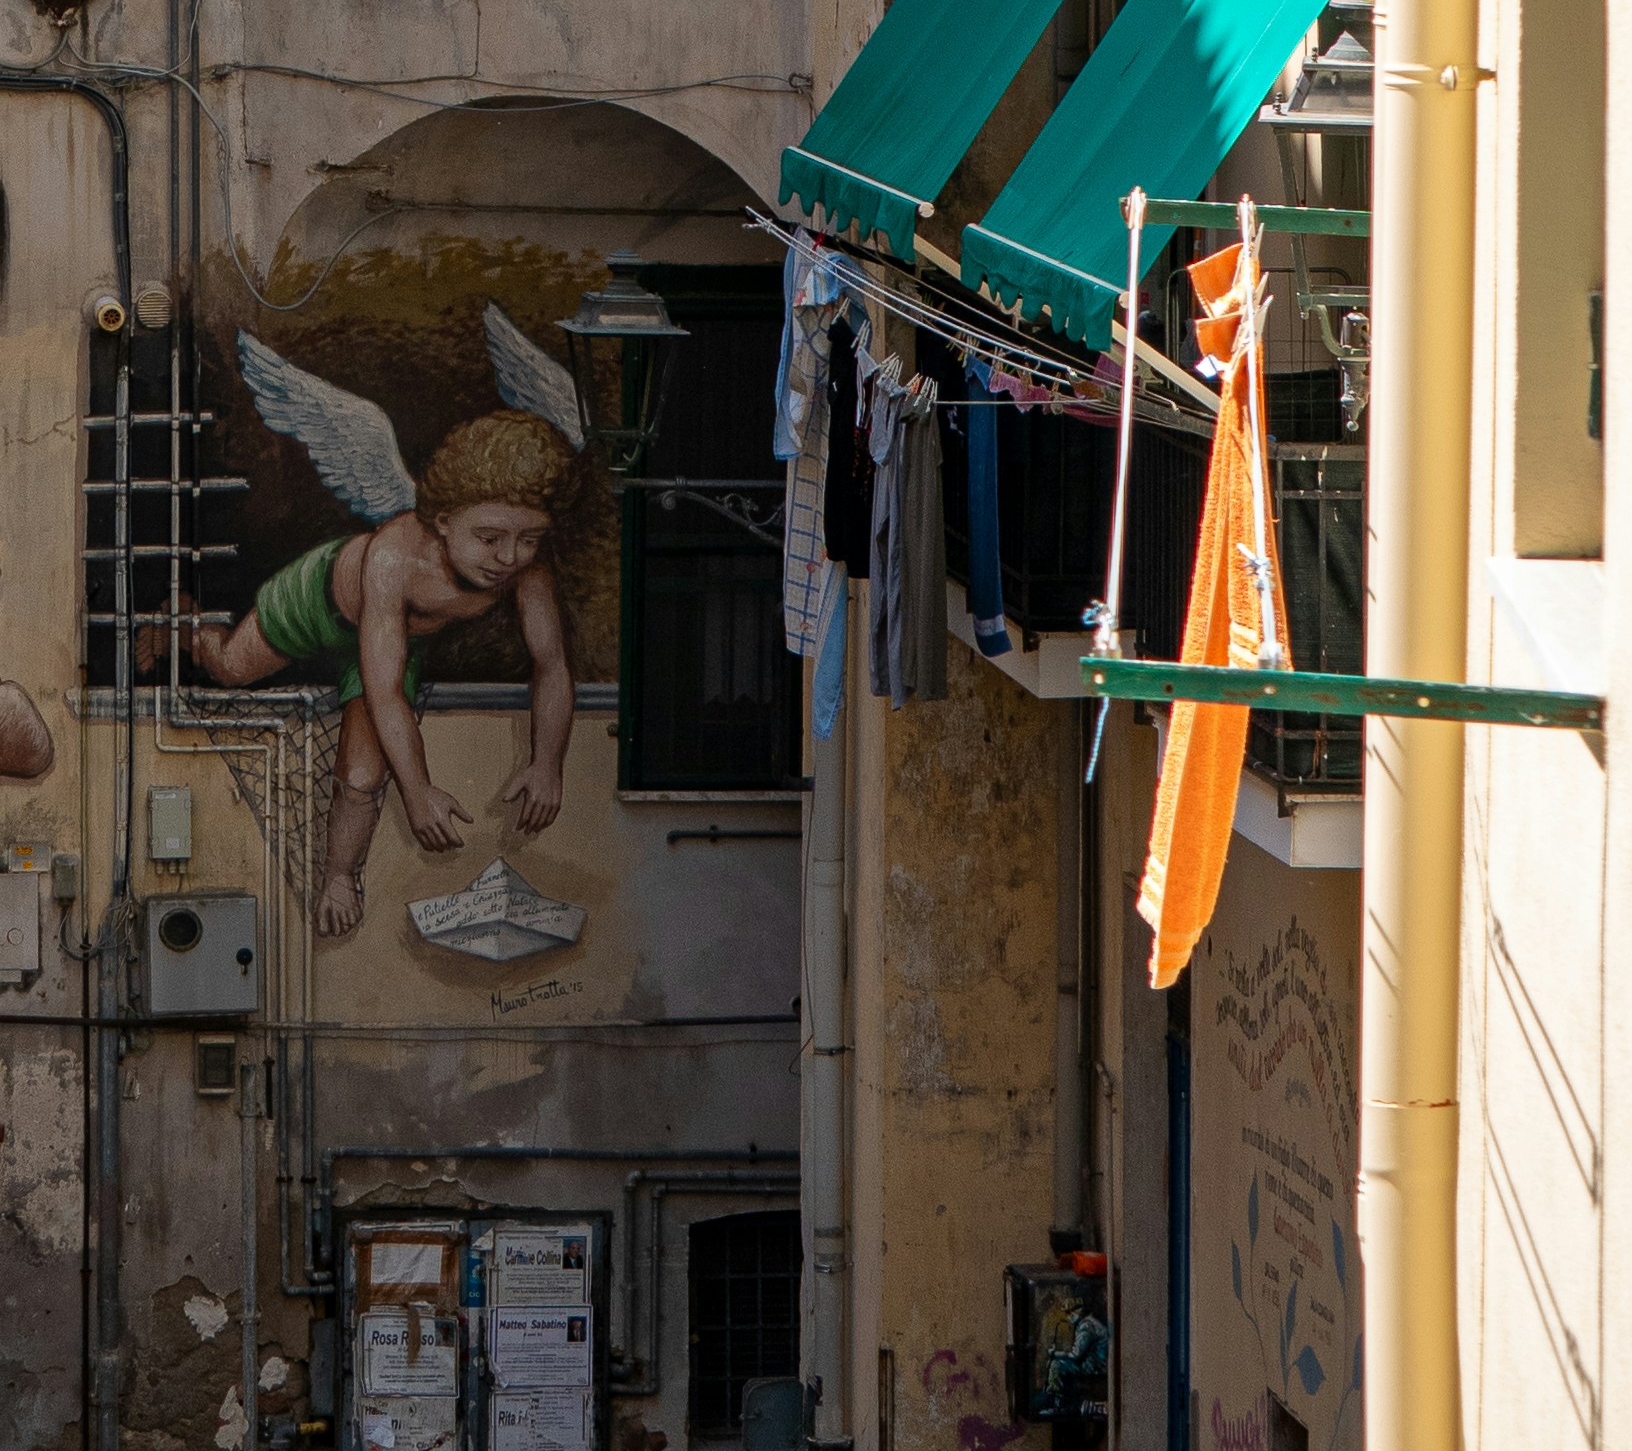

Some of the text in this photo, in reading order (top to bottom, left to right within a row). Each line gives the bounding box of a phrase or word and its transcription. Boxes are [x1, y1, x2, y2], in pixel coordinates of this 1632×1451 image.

[499, 1319, 567, 1330] Matteo Sabatino
[372, 1331, 434, 1347] Rosa Rso
[499, 1411, 516, 1426] Rita
